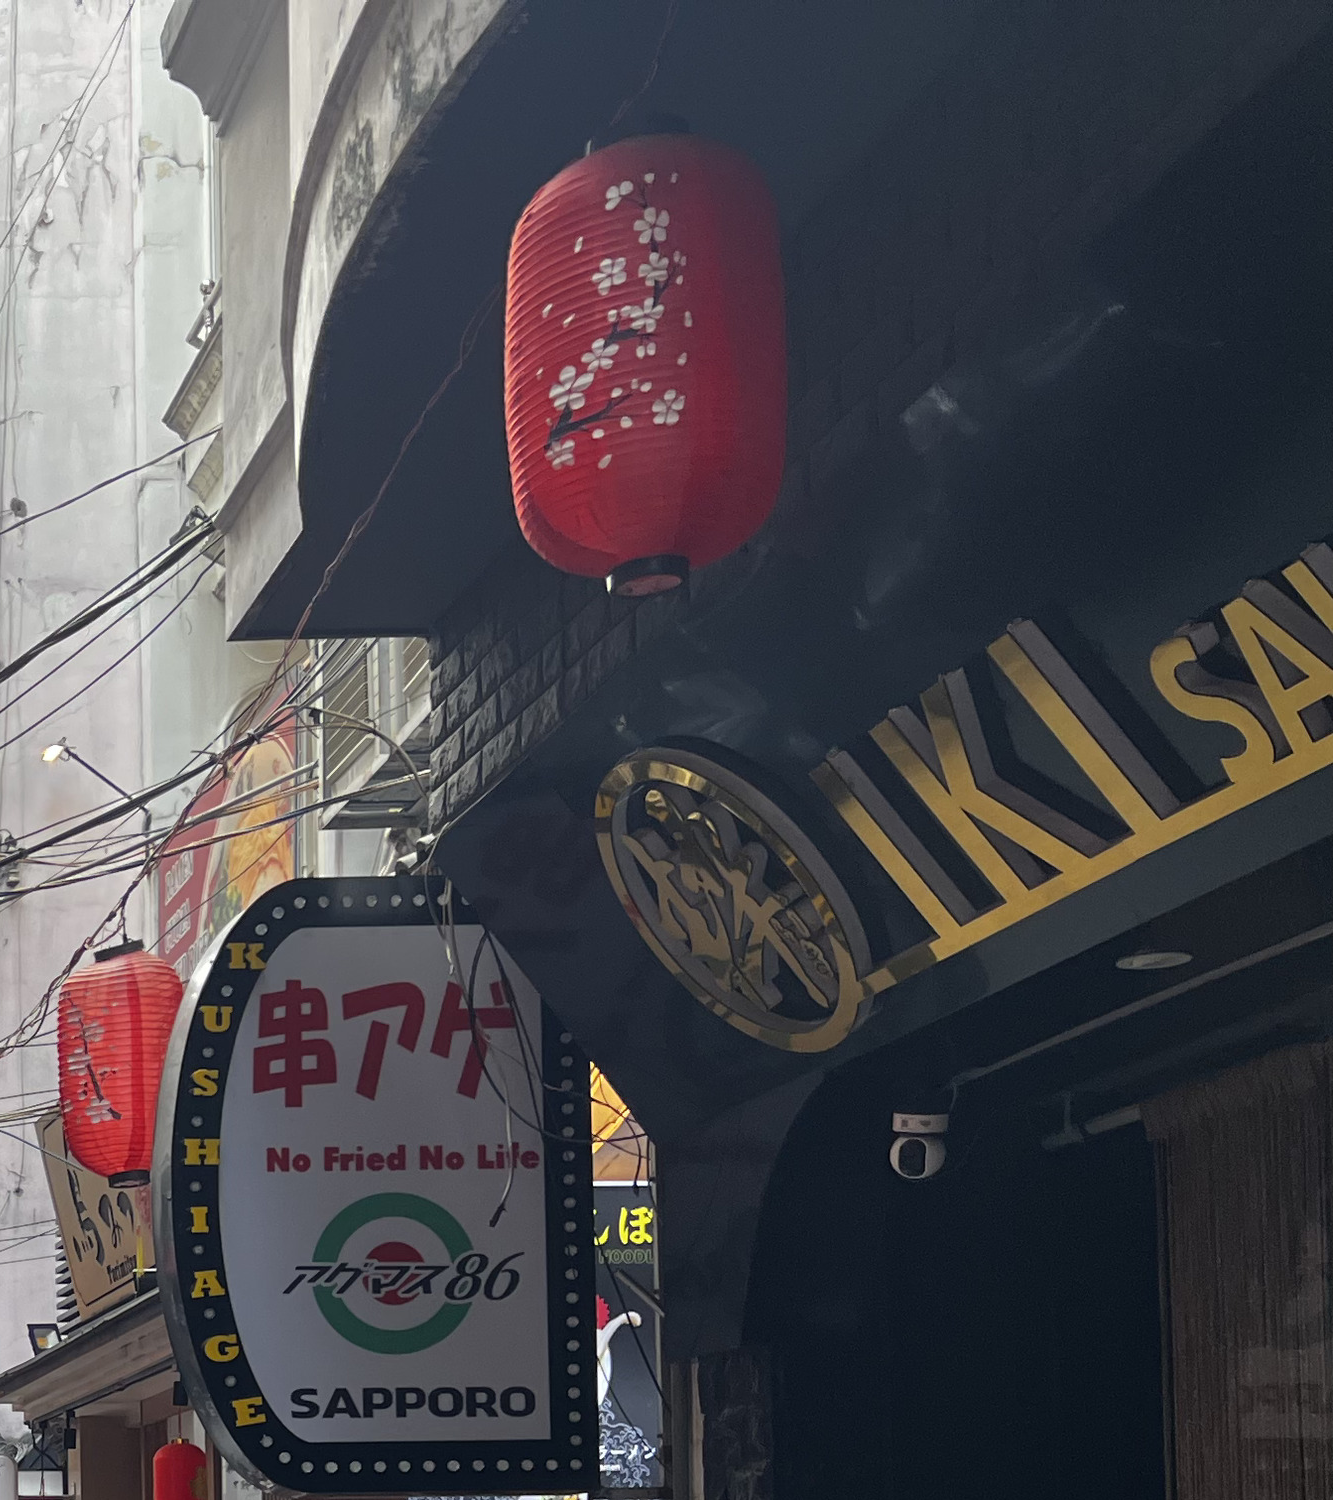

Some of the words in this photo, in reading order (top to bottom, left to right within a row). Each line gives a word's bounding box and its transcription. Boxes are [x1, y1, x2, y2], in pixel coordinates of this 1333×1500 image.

[809, 616, 1173, 945] IKI
[1149, 542, 1333, 785] SA
[252, 979, 517, 1109] 串アゲ
[183, 941, 268, 1429] KUSHIAGE
[266, 1145, 310, 1174] No
[324, 1144, 407, 1173] Fried
[418, 1143, 465, 1171] No
[477, 1141, 541, 1170] Life
[291, 1387, 537, 1419] SAPPORO
